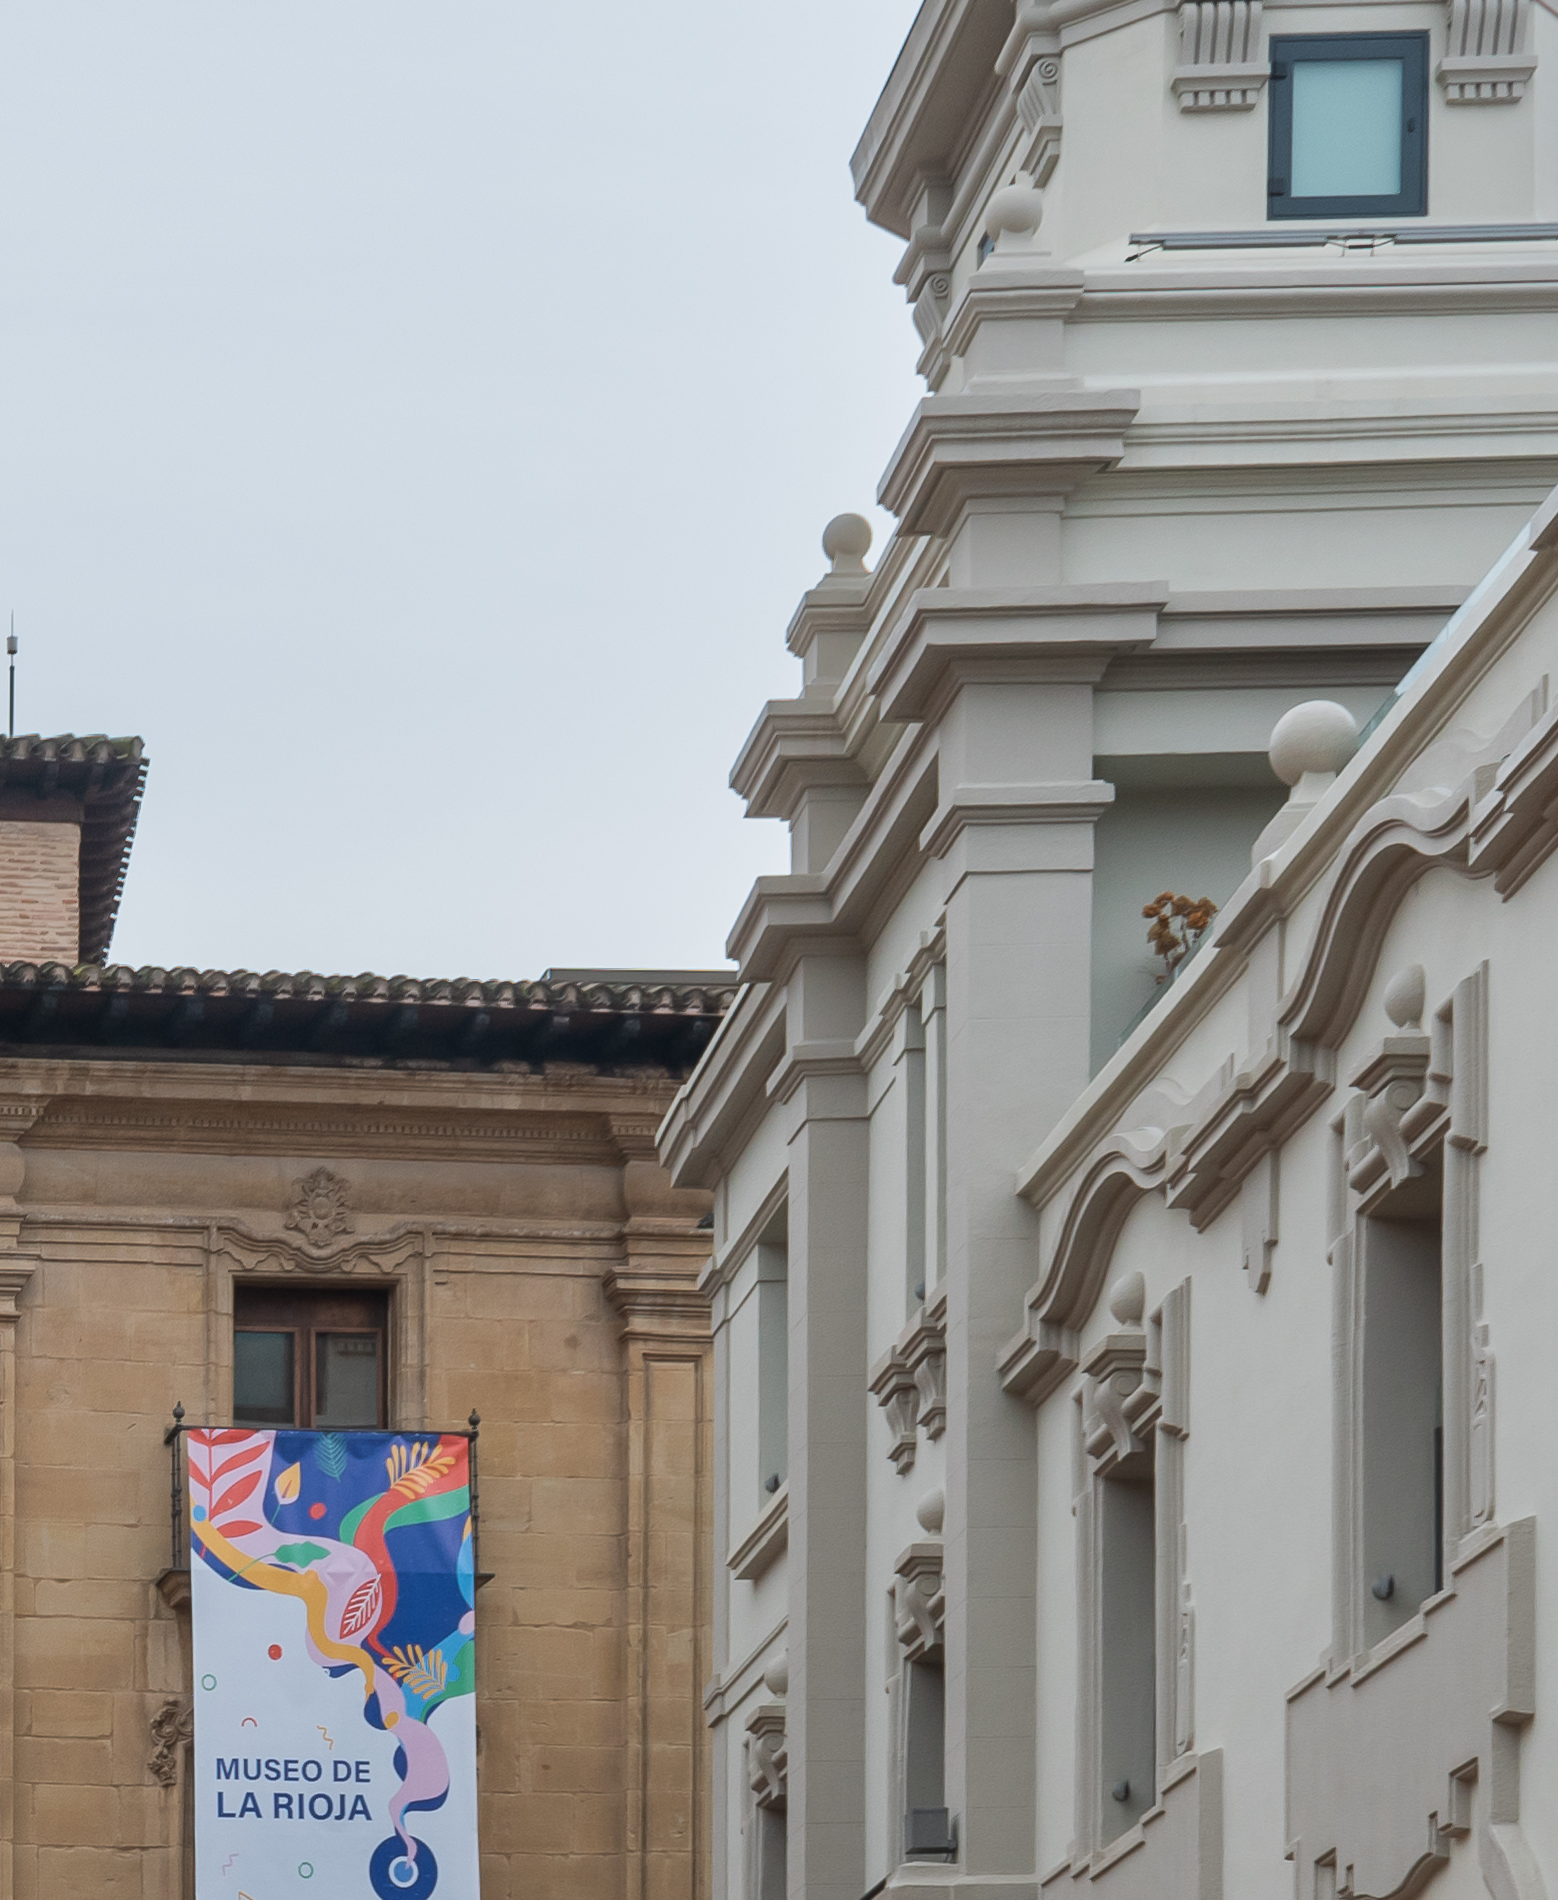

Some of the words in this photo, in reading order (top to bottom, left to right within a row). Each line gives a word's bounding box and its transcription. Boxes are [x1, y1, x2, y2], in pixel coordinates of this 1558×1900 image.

[216, 1758, 322, 1782] MUSEO
[333, 1760, 371, 1783] DE
[217, 1791, 263, 1818] LA
[273, 1793, 373, 1821] RIOJA
